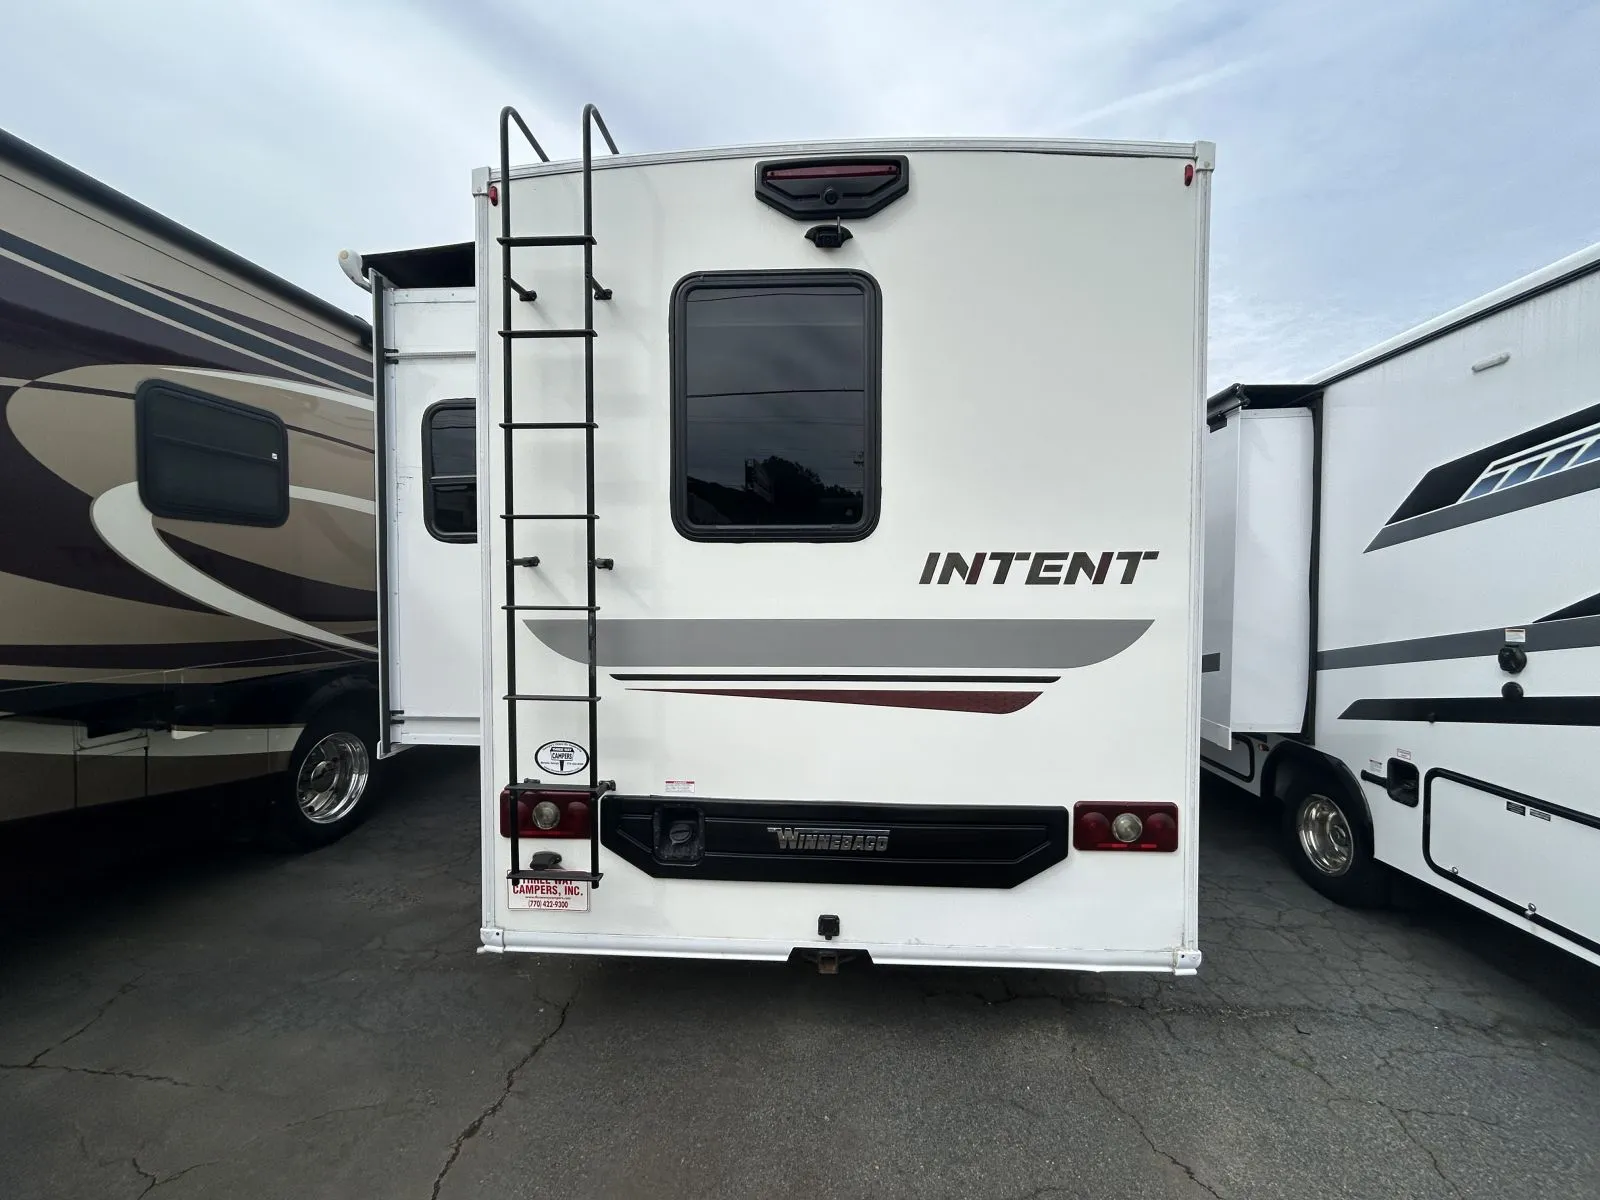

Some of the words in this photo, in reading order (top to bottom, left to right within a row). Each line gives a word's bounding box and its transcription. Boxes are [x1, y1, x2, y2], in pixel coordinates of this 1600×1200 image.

[919, 551, 1160, 585] INTENT
[552, 752, 573, 760] CAMPERS
[767, 827, 890, 851] WINNEBAGO
[512, 884, 561, 897] CAMPERS,
[564, 886, 584, 896] INC.
[528, 900, 542, 908] (770)
[543, 900, 569, 909] 422-9300
